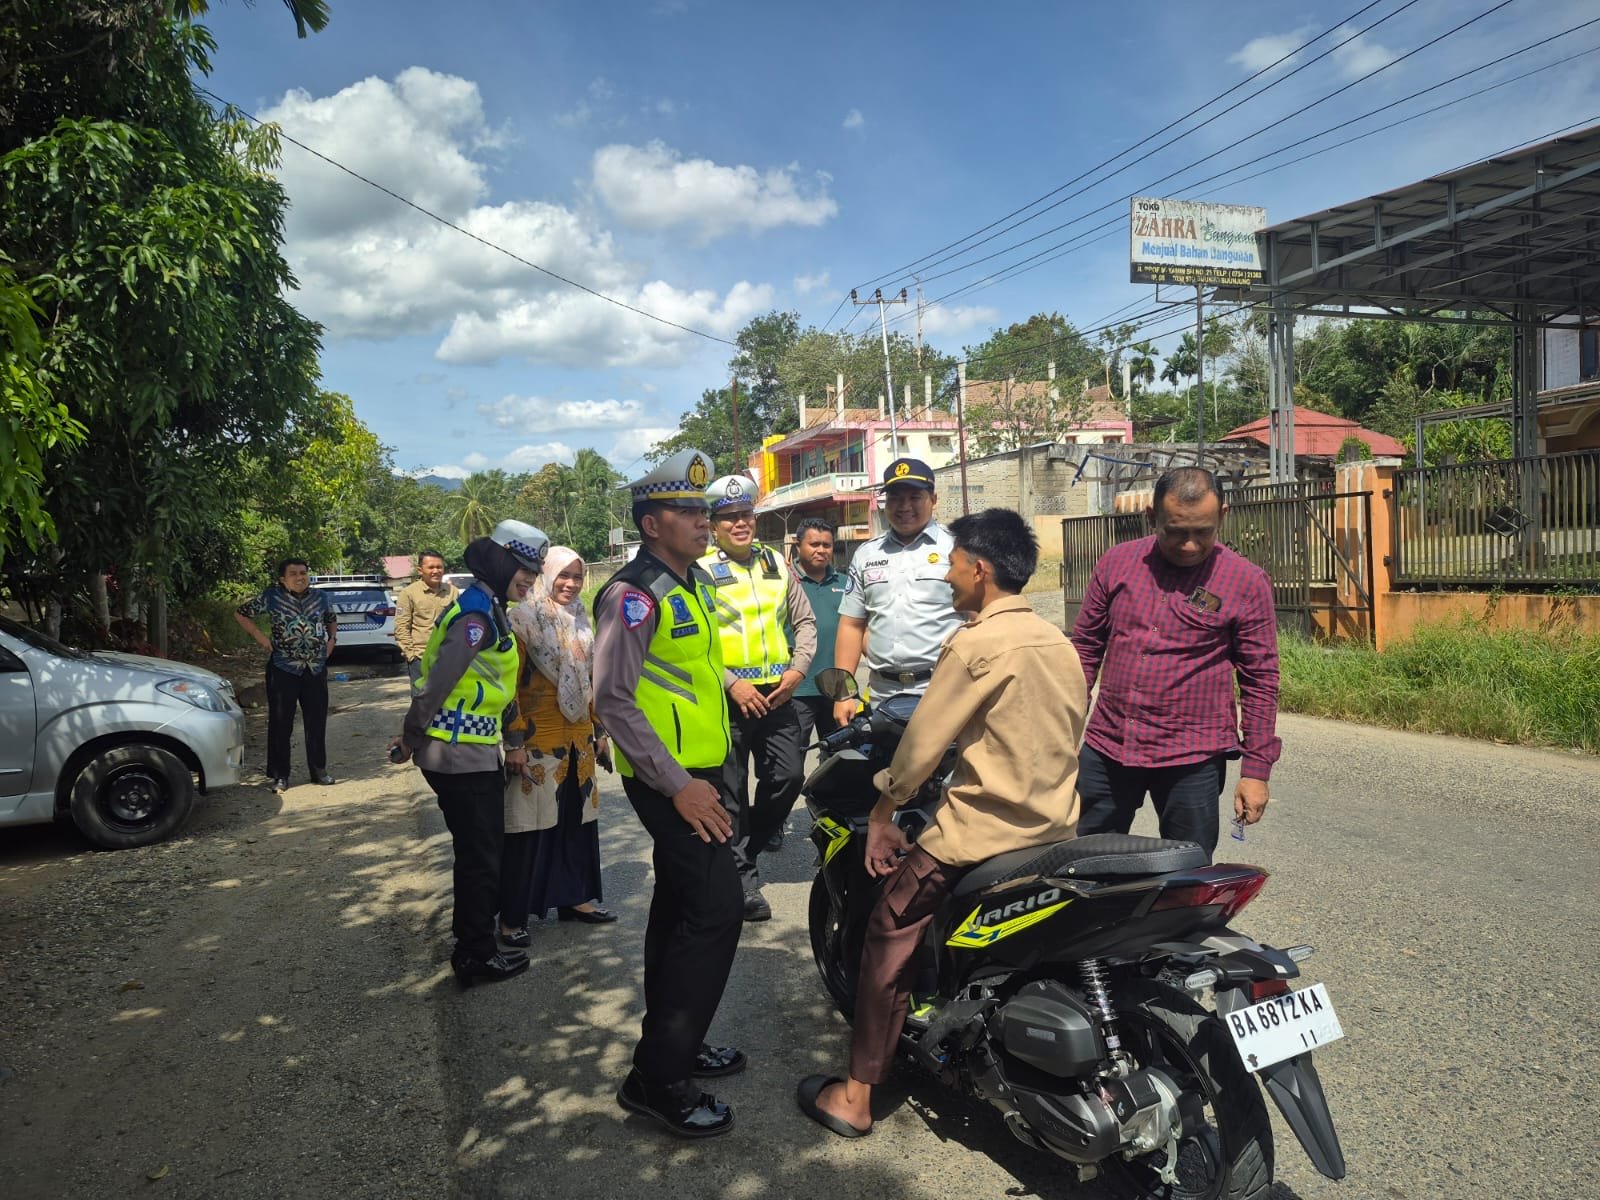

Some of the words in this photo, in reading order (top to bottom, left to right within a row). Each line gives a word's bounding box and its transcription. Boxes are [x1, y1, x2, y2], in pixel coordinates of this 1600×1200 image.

[1138, 202, 1160, 212] TOKO
[1135, 214, 1197, 240] ZAHRA
[1142, 241, 1178, 259] Menjual
[1179, 244, 1209, 258] Bahan
[864, 559, 889, 569] SHANDI
[966, 887, 1061, 933] VARIO
[1230, 1010, 1259, 1039] BA
[1256, 995, 1302, 1030] 6872
[1297, 988, 1324, 1016] KA
